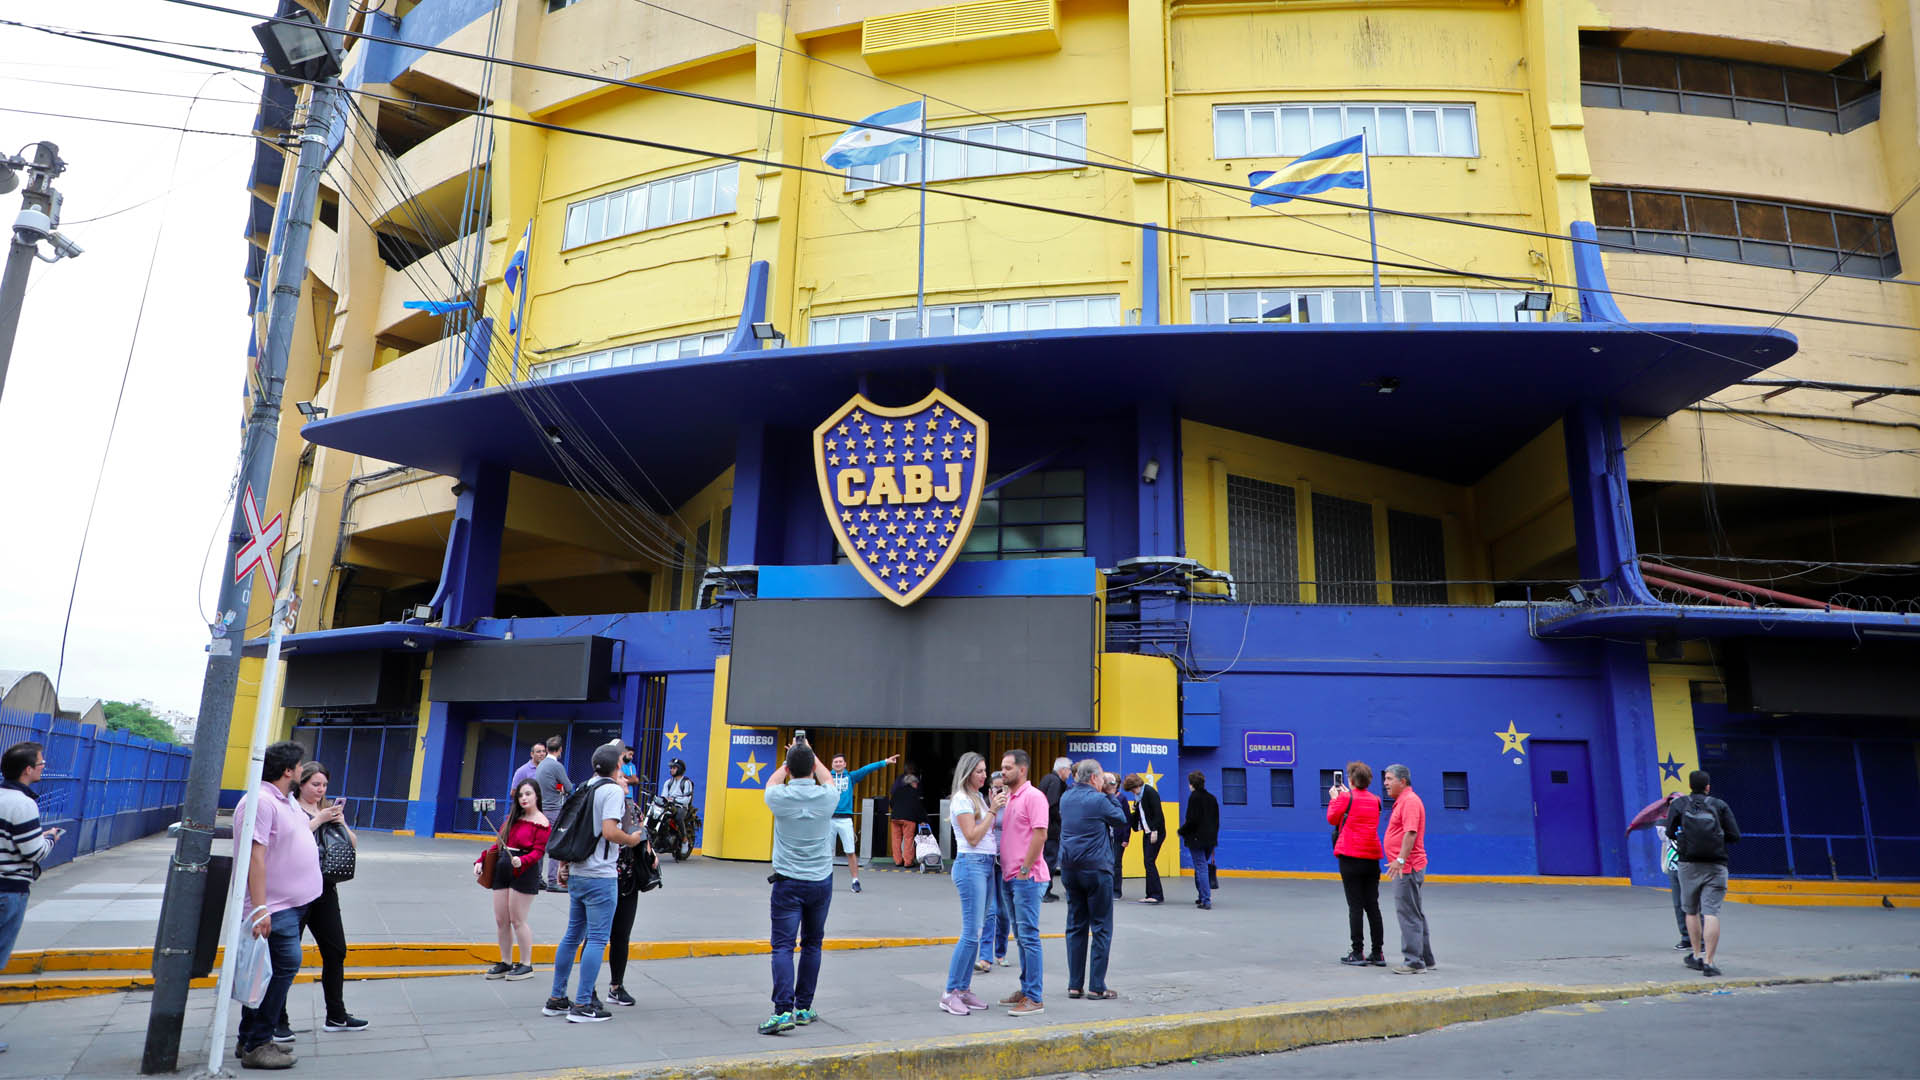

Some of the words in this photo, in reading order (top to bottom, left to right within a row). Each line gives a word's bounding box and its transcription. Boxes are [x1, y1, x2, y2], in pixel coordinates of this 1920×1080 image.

[836, 463, 963, 507] CABJ
[673, 735, 679, 744] 2
[732, 735, 774, 746] INGRESO
[1508, 733, 1516, 743] 3
[1069, 742, 1117, 753] INGRESO
[1131, 743, 1168, 755] INGRESO
[745, 763, 757, 777] 3
